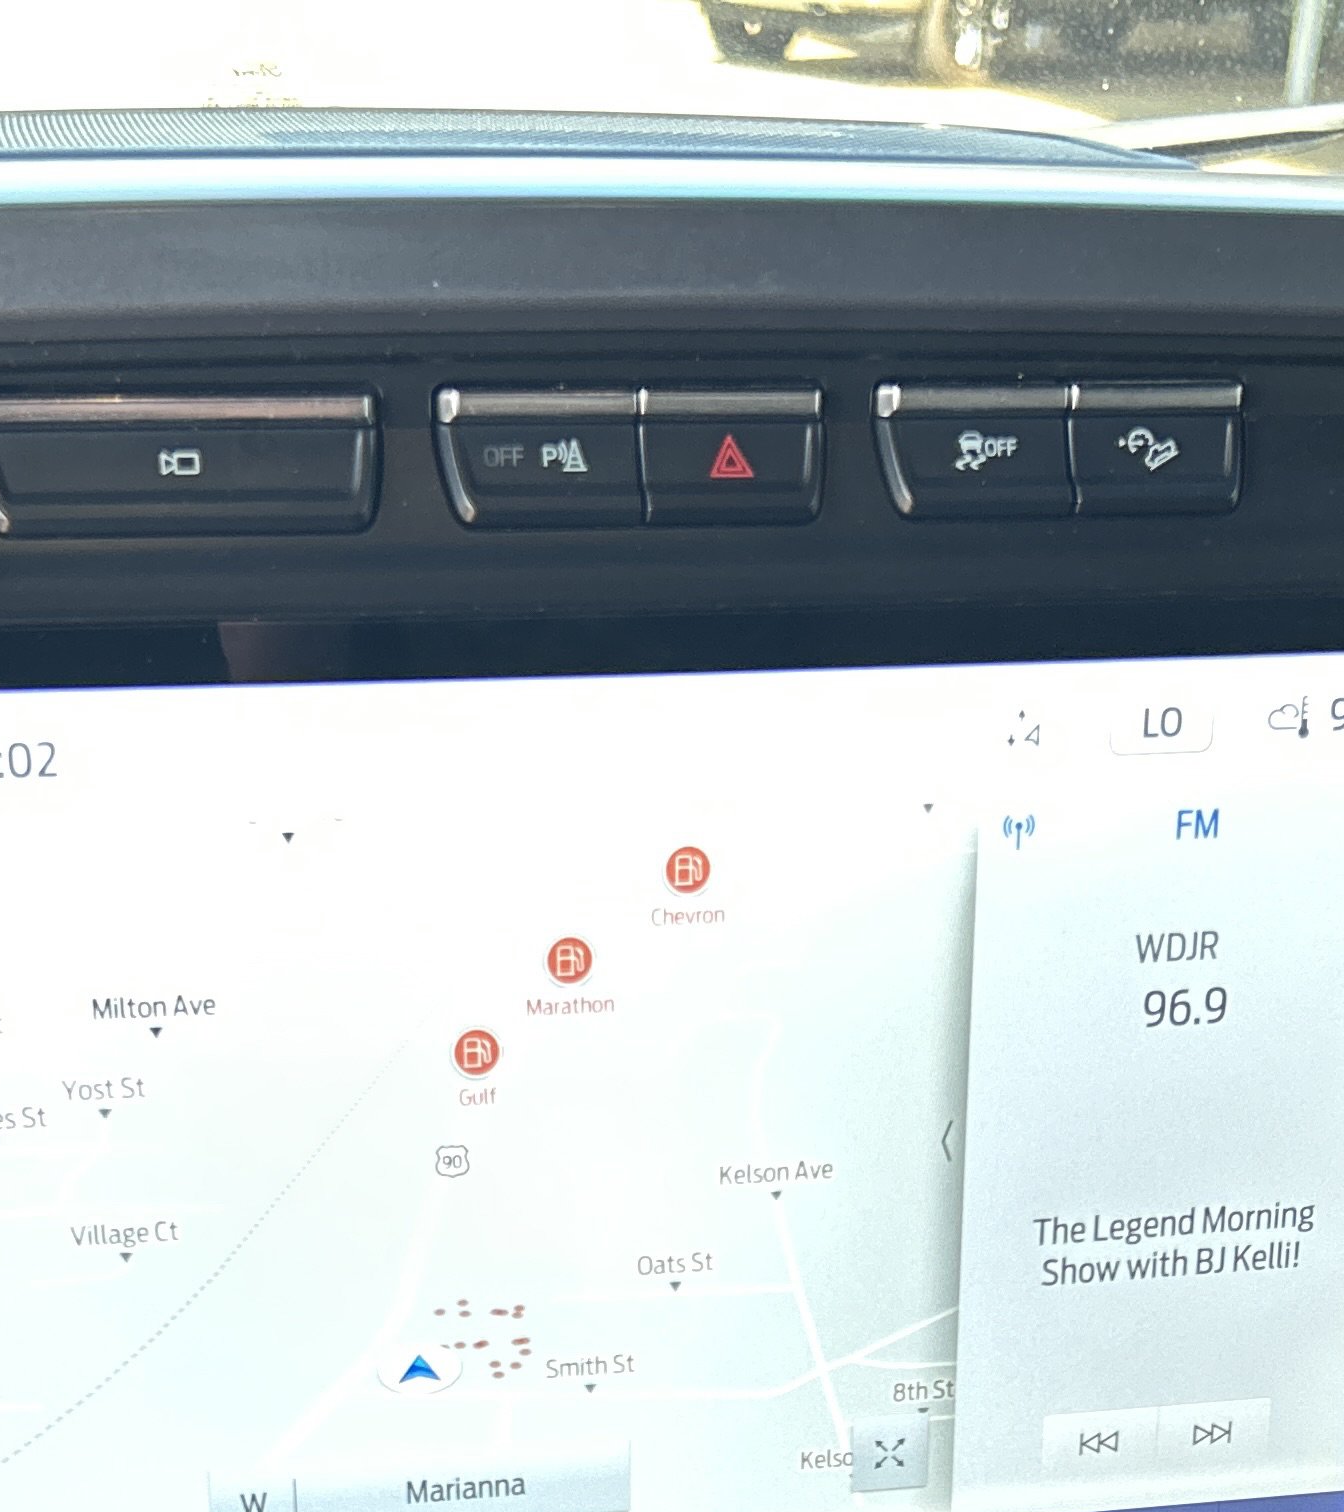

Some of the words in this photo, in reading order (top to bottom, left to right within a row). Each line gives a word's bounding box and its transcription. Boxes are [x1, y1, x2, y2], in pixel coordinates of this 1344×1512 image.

[482, 445, 524, 467] OFF
[984, 437, 1017, 457] OFF
[1142, 707, 1183, 738] LO
[1176, 808, 1220, 839] FM
[651, 907, 726, 927] Chevron
[1135, 930, 1220, 964] WDJR
[92, 996, 167, 1021] Milton
[173, 994, 216, 1016] Ave
[525, 997, 616, 1017] Marathon
[1143, 986, 1229, 1028] 96.9
[61, 1077, 115, 1103] Yost
[120, 1075, 147, 1099] St
[459, 1087, 497, 1107] Gulf
[22, 1106, 48, 1128] St
[442, 1154, 463, 1171] 90
[719, 1164, 789, 1186] Kelson
[794, 1160, 834, 1181] Ave
[70, 1223, 150, 1248] Village
[153, 1220, 180, 1244] Ct
[1033, 1216, 1086, 1247] The
[1093, 1206, 1196, 1245] Legend
[1202, 1201, 1316, 1233] Morning
[637, 1255, 686, 1276] Oats
[691, 1252, 713, 1272] St
[1041, 1256, 1121, 1287] Show
[1126, 1248, 1188, 1280] with
[1195, 1246, 1227, 1275] BJ
[1232, 1240, 1301, 1273] Kelli!
[546, 1356, 607, 1379] Smith
[613, 1354, 635, 1374] St
[893, 1381, 928, 1402] 8th
[932, 1379, 954, 1399] St
[405, 1476, 526, 1505] Marianna
